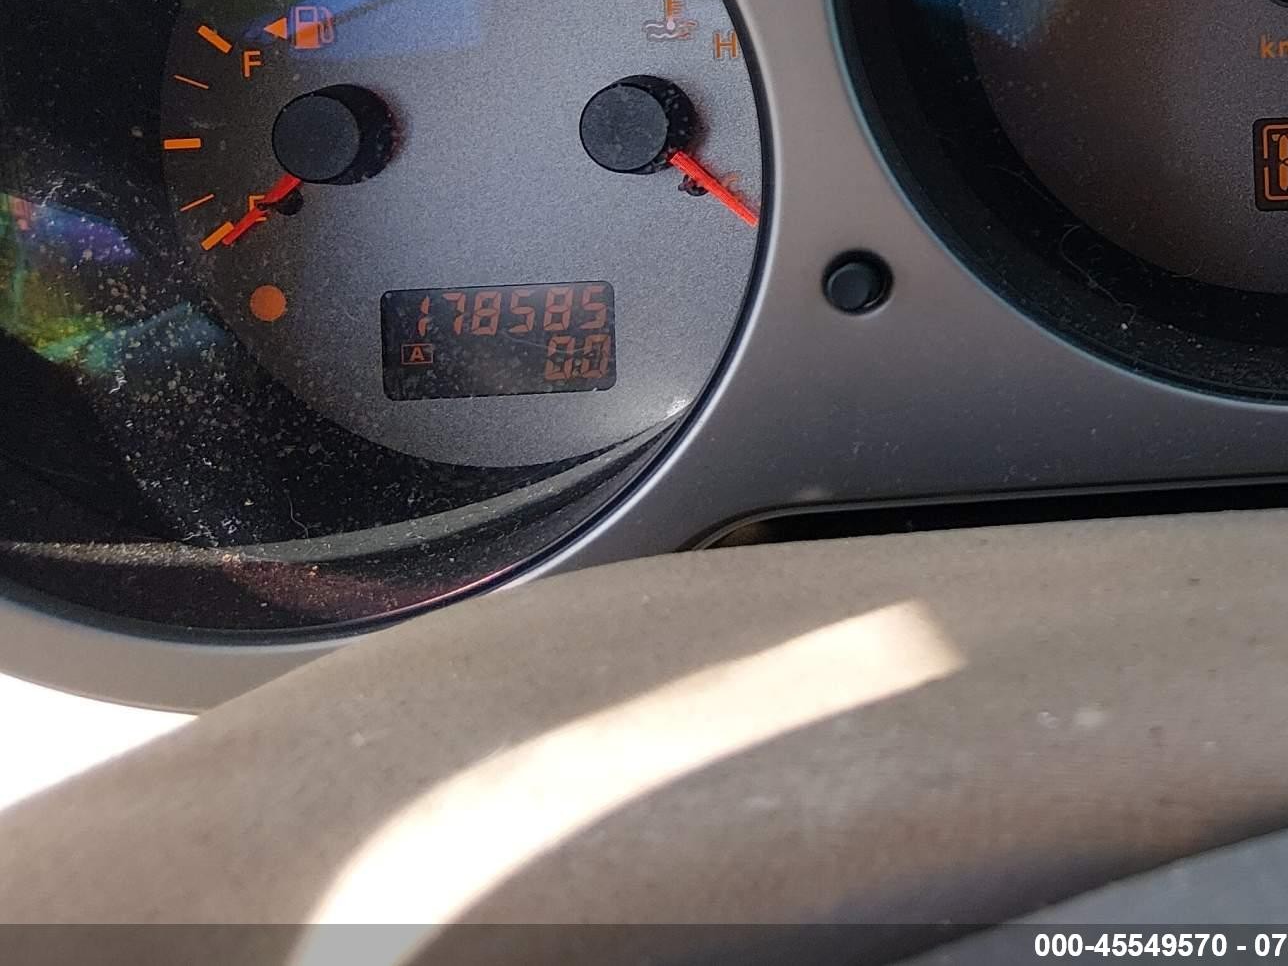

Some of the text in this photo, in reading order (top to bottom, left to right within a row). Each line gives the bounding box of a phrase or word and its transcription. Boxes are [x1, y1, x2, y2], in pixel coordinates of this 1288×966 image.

[713, 32, 737, 59] H
[242, 50, 263, 78] F
[416, 286, 609, 336] 178585
[409, 345, 425, 362] A
